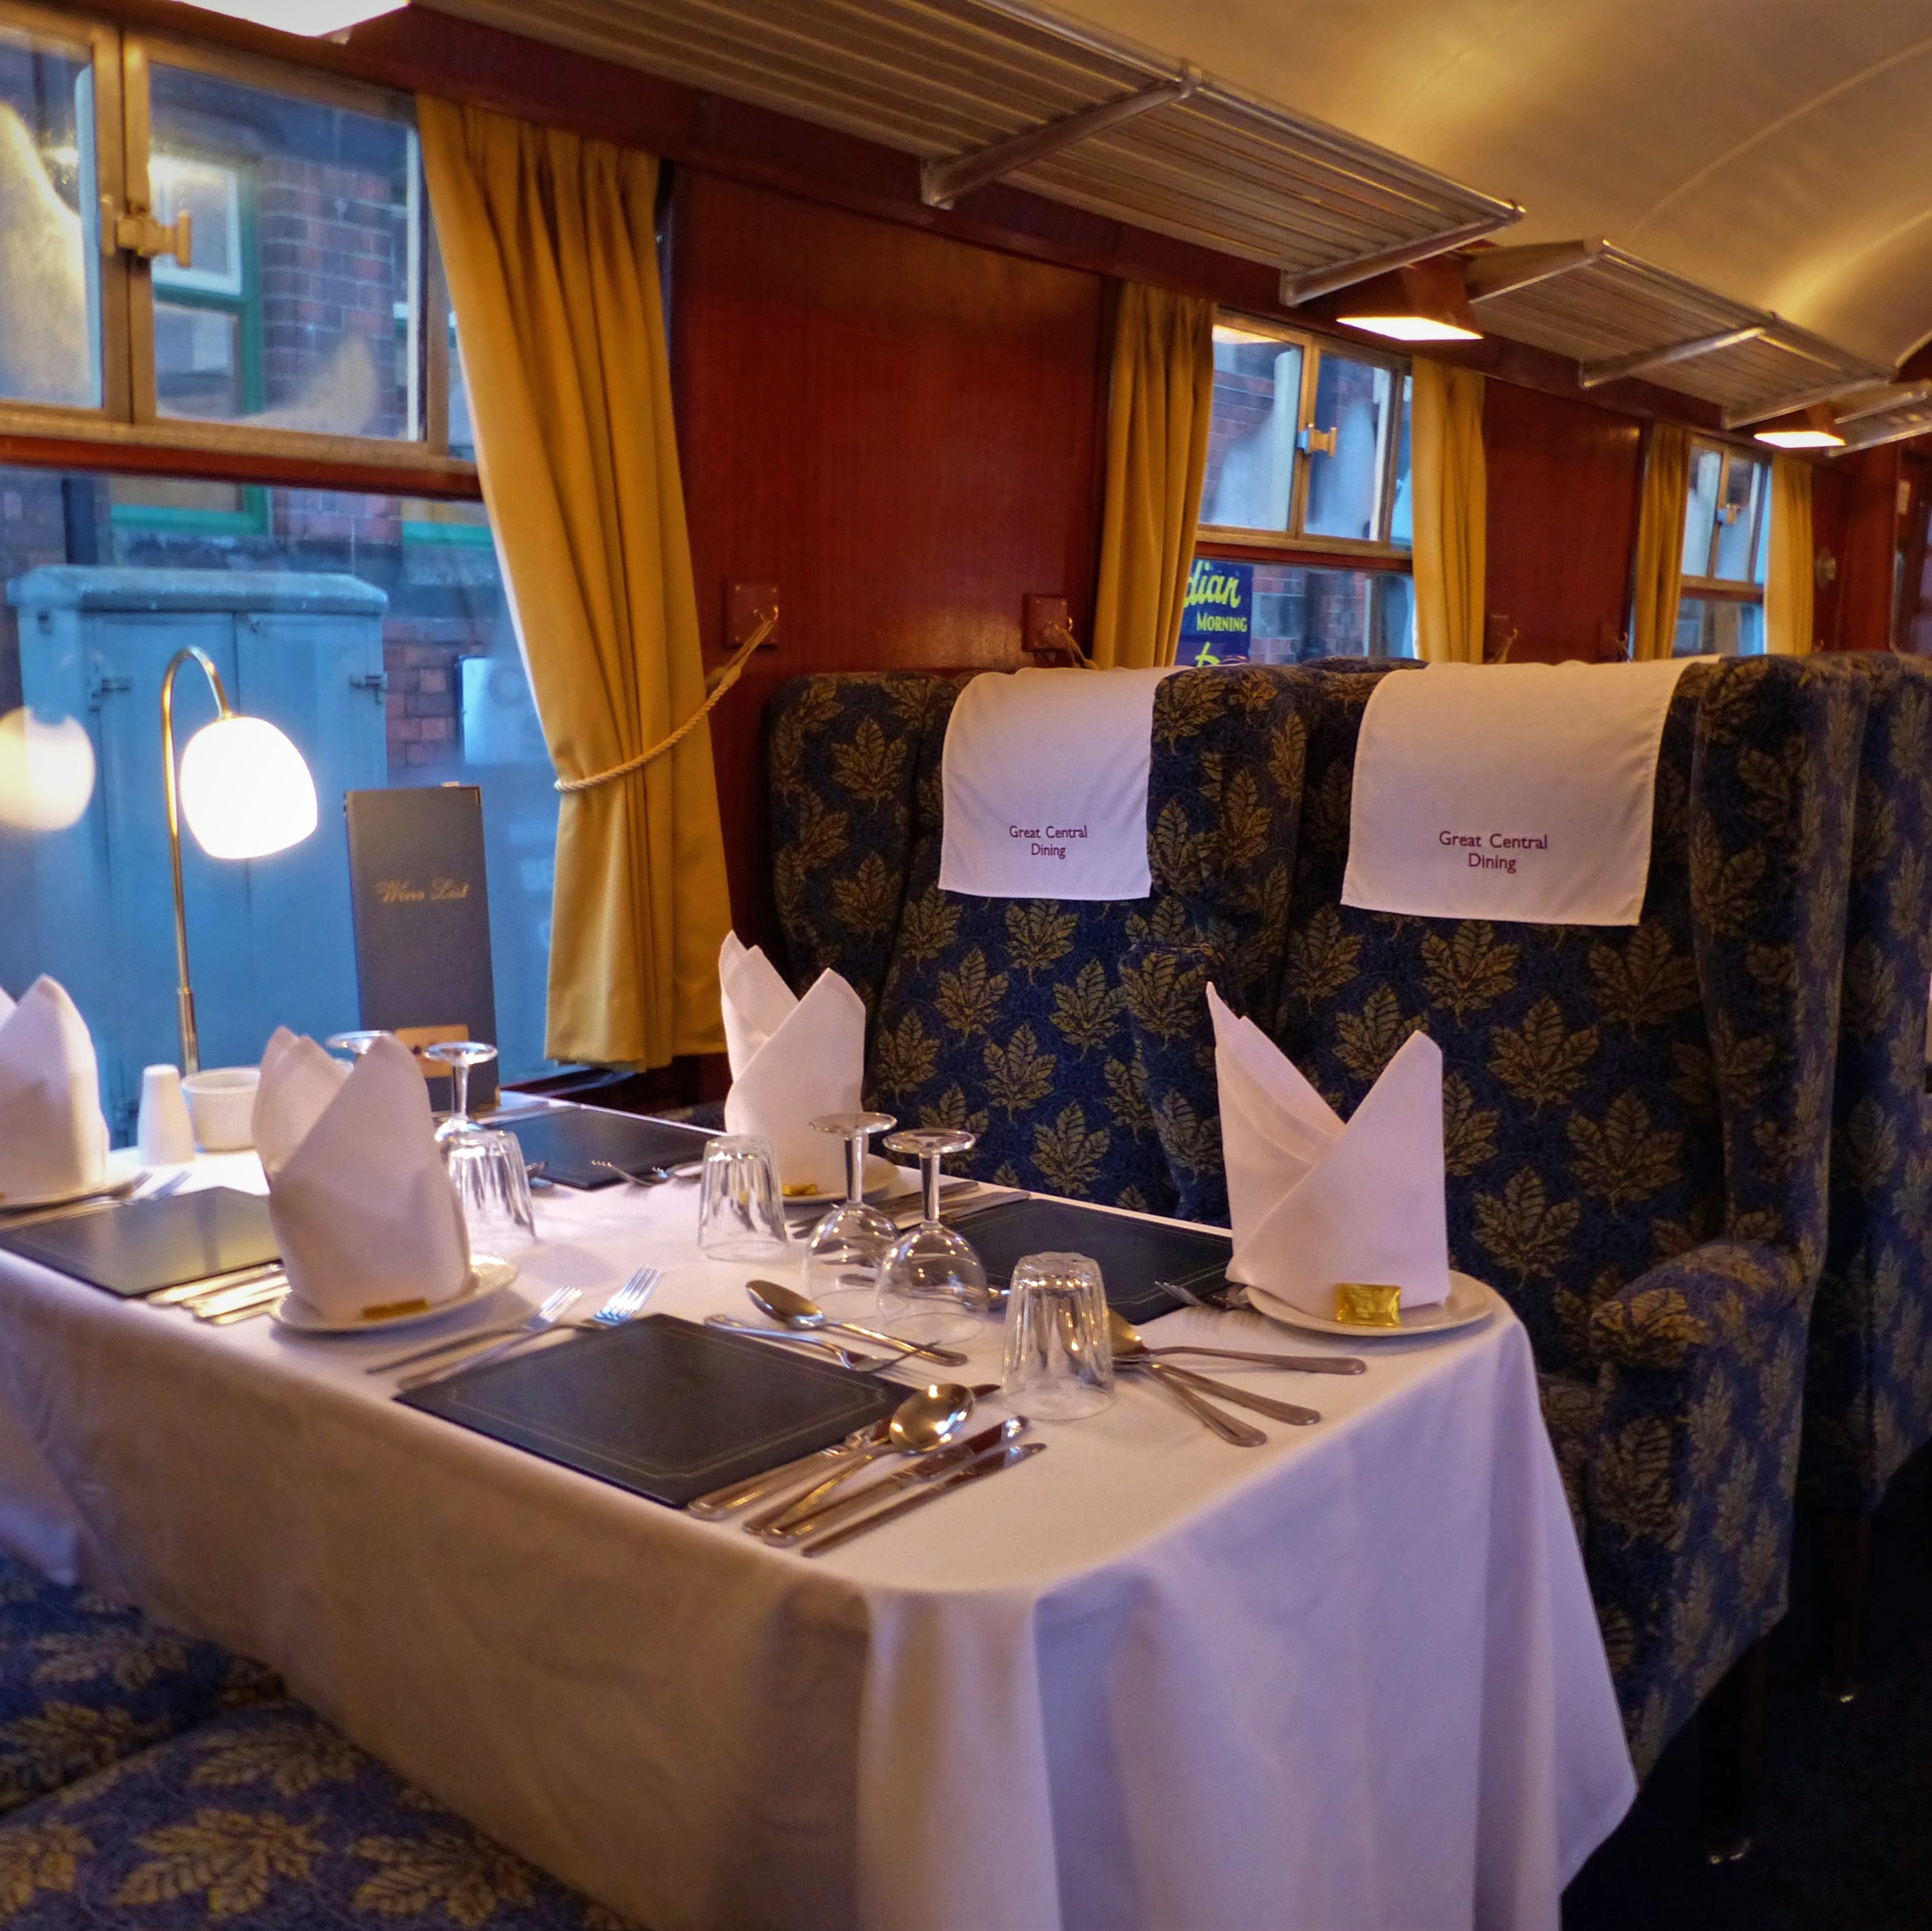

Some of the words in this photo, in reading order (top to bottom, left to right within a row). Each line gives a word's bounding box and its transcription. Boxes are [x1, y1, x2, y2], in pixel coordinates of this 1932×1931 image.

[1197, 610, 1248, 632] MORNING
[1009, 825, 1040, 839] Great
[1045, 825, 1088, 839] Central
[1439, 831, 1482, 847] Great
[1490, 833, 1548, 850] Central
[1031, 843, 1066, 860] Dining
[1468, 853, 1517, 874] Dining
[376, 881, 425, 903] Wine
[430, 878, 469, 901] List
